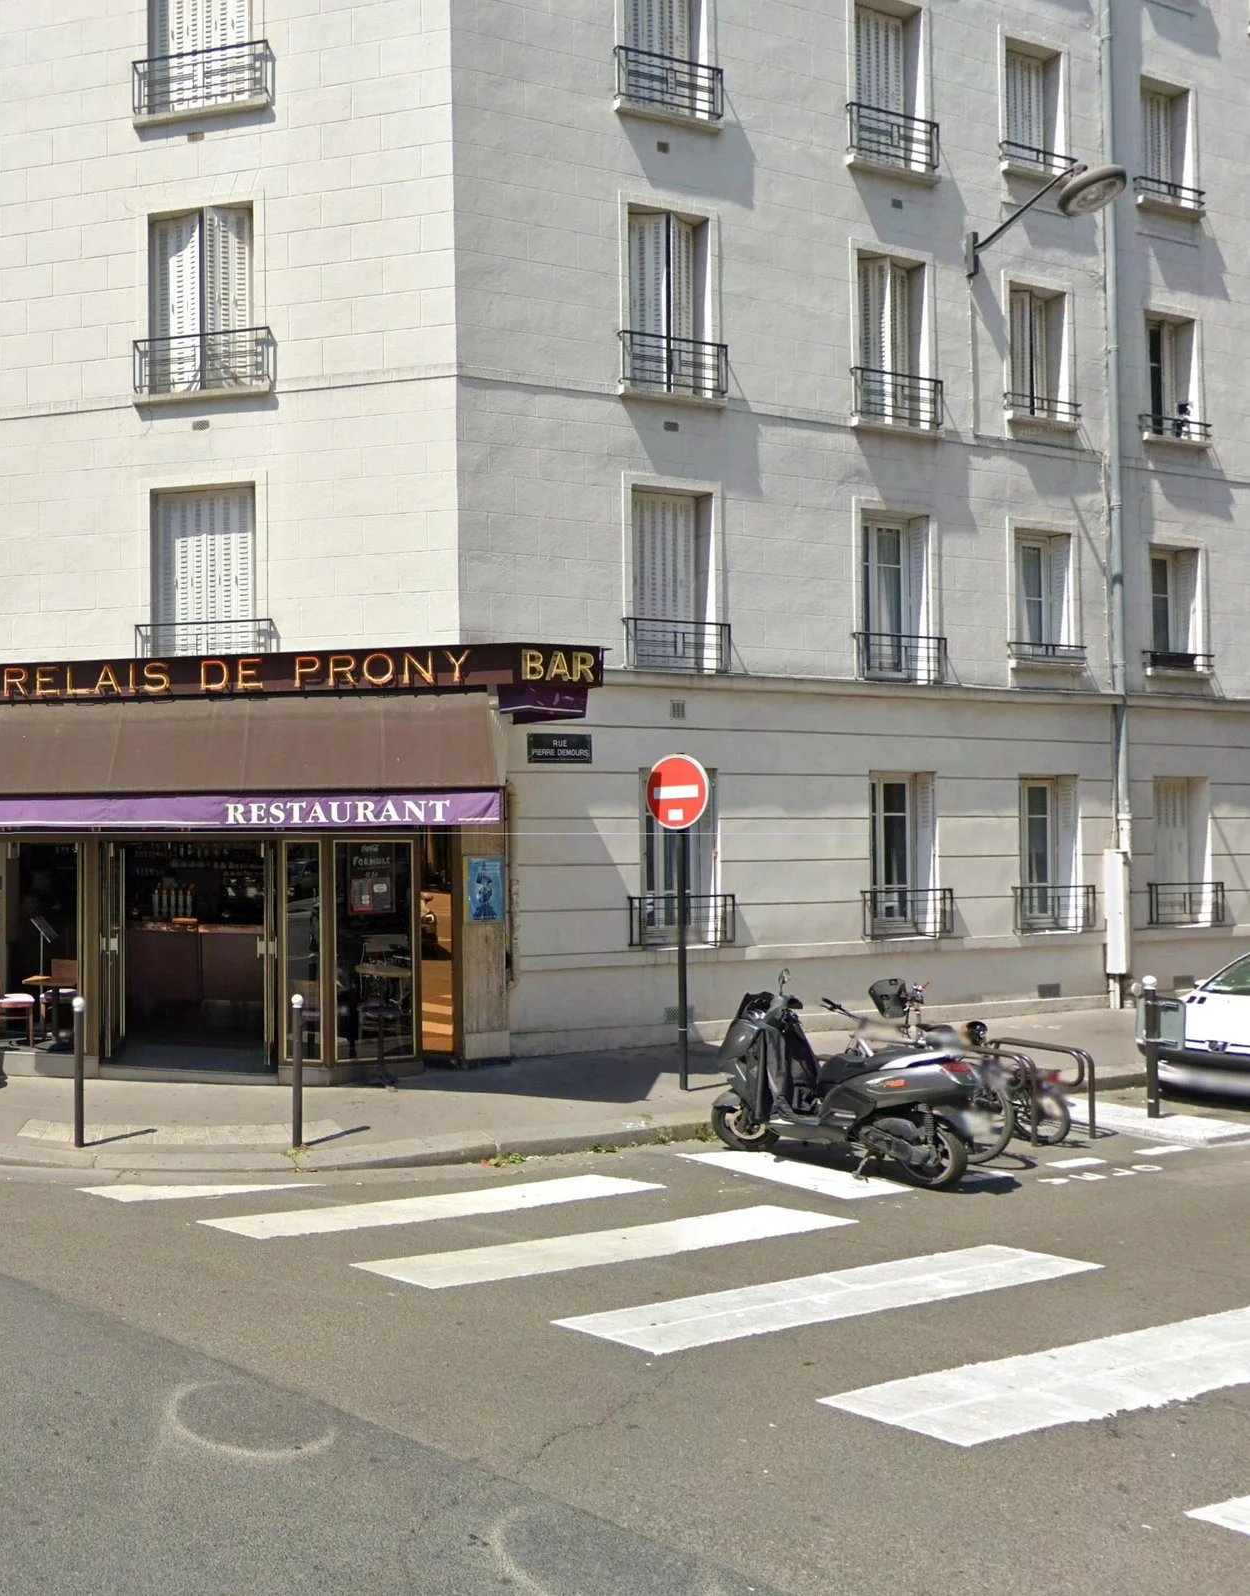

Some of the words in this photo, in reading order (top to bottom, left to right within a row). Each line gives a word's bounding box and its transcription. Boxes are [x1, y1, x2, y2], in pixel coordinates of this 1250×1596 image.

[3, 662, 171, 697] RELAIS
[200, 658, 264, 690] DE
[294, 650, 470, 688] PRONY
[521, 648, 595, 683] BAR
[531, 748, 555, 756] PIERRE
[557, 748, 589, 757] DEMOURS
[552, 739, 568, 748] RUE
[225, 799, 450, 825] RESTAURANT
